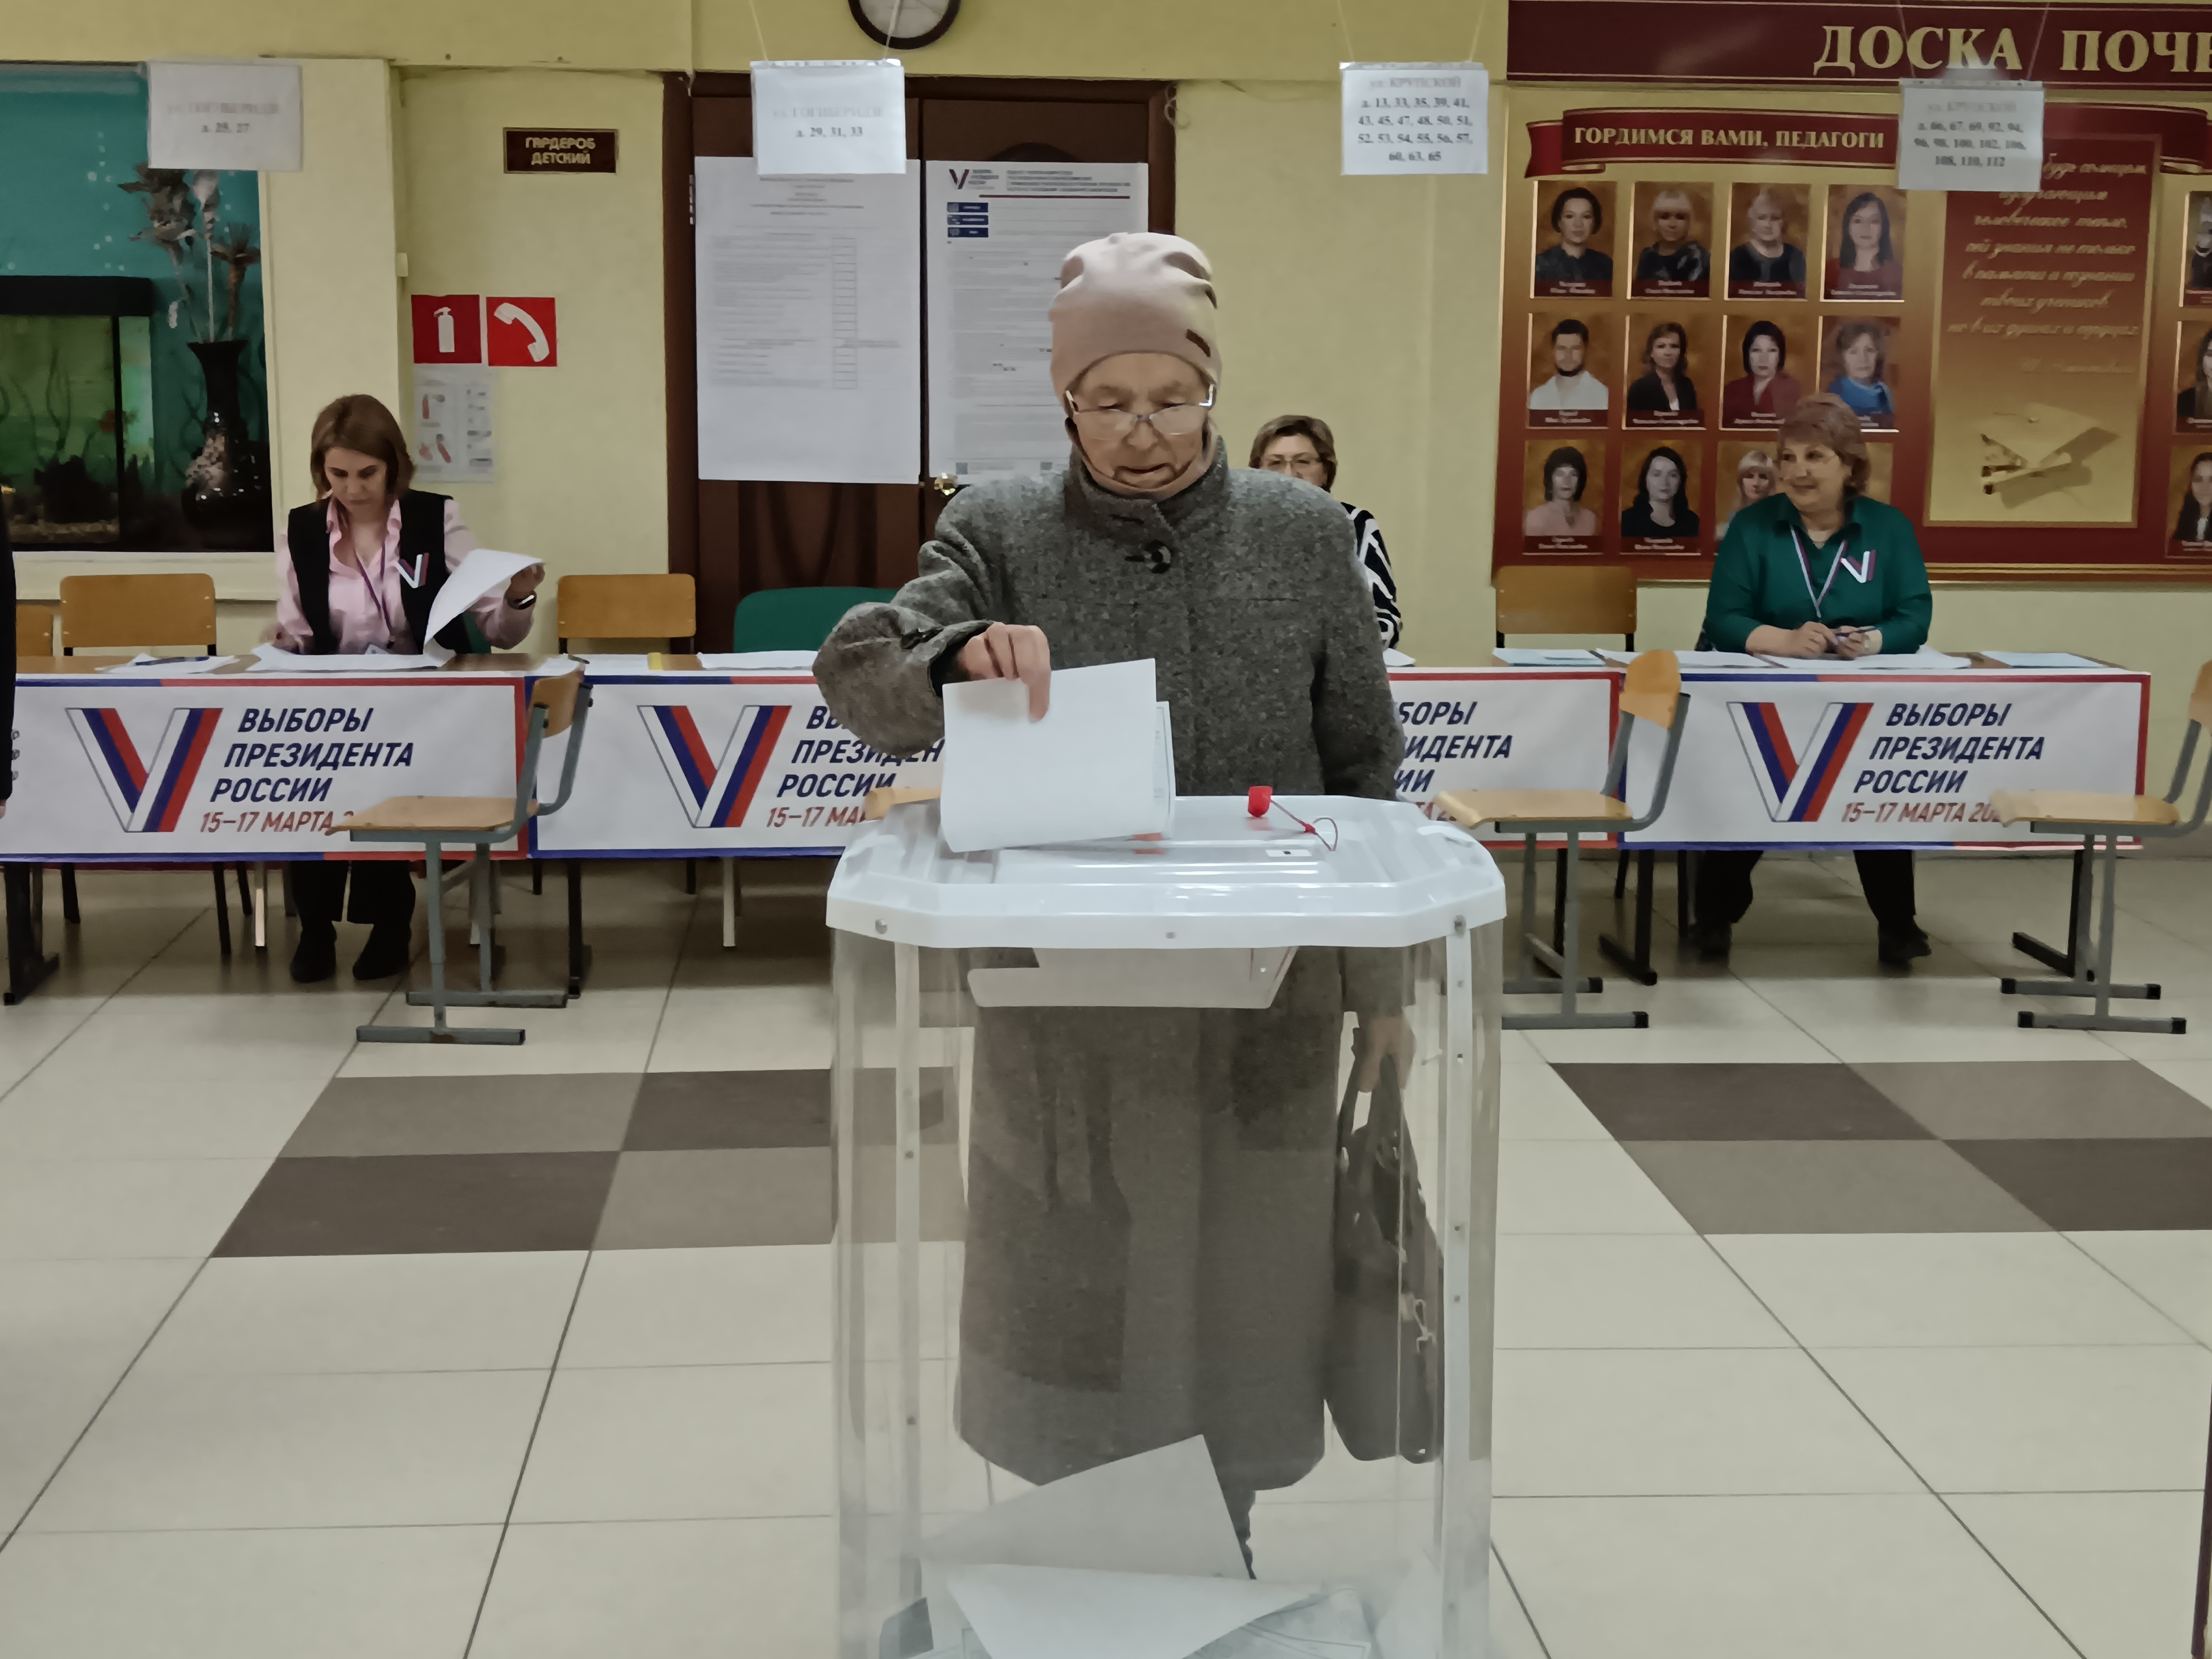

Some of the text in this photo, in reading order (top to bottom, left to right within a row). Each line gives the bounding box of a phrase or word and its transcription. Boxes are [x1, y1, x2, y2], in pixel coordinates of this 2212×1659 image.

[1813, 26, 2023, 76] ДОСКА
[1377, 115, 1394, 126] 45,
[1456, 115, 1473, 126] 51,
[1417, 133, 1433, 144] 55,
[1456, 133, 1473, 144] 57,
[1575, 127, 1693, 146] ГОРДИМСЯ
[1776, 131, 1884, 149] ПЕДАГОГИ
[531, 150, 590, 165] ДЕТСКИЙ
[238, 708, 374, 732] ВЫБОРЫ
[1886, 703, 2013, 726] ВЫБОРЫ
[224, 742, 414, 771] ПРЕЗИДЕНТА
[1404, 735, 1513, 762] ИДЕНТА
[1869, 736, 2044, 763] ПРЕЗИДЕНТА
[210, 778, 333, 802] РОССИИ
[1853, 770, 1968, 793] РОССИИ
[261, 811, 334, 832] МАРТА
[1898, 802, 1965, 822] МАРТА
[1968, 802, 2000, 822] 20
